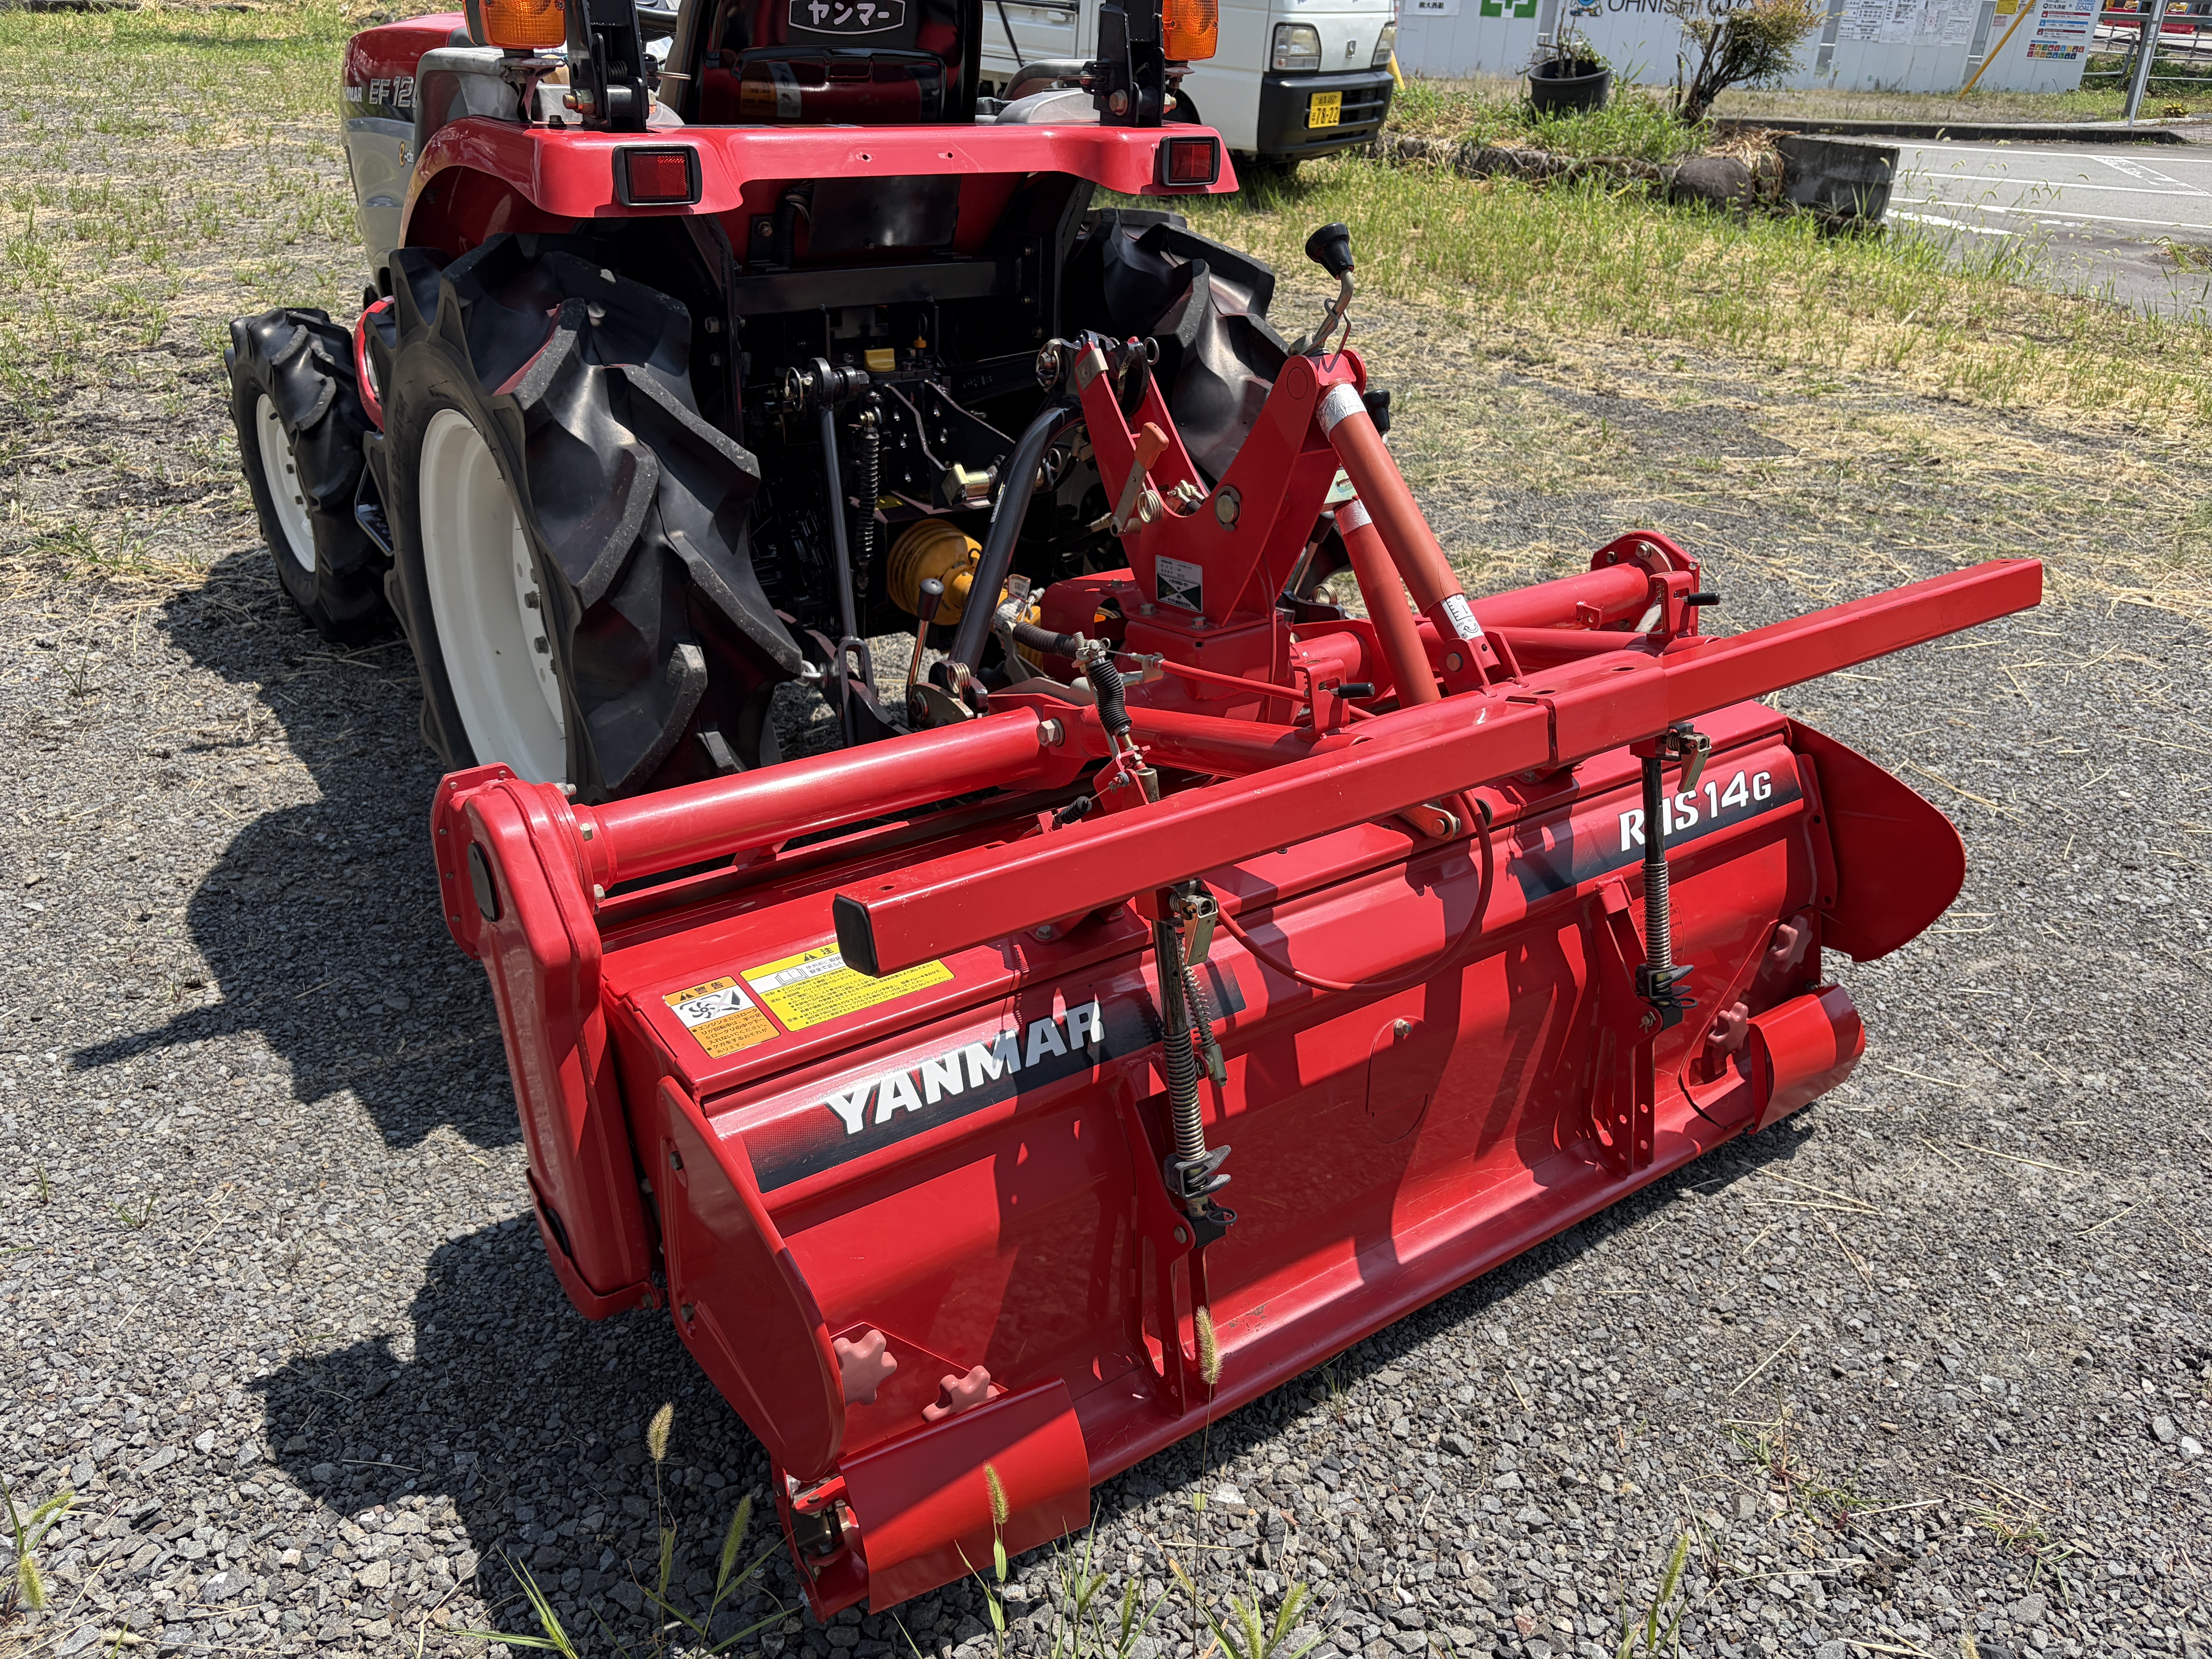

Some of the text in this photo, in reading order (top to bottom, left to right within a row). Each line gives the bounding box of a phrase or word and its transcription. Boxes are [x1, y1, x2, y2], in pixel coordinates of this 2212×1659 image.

[808, 0, 890, 26] ヤンマー
[694, 981, 724, 994] 警告
[828, 1001, 1104, 1135] YANMAR
